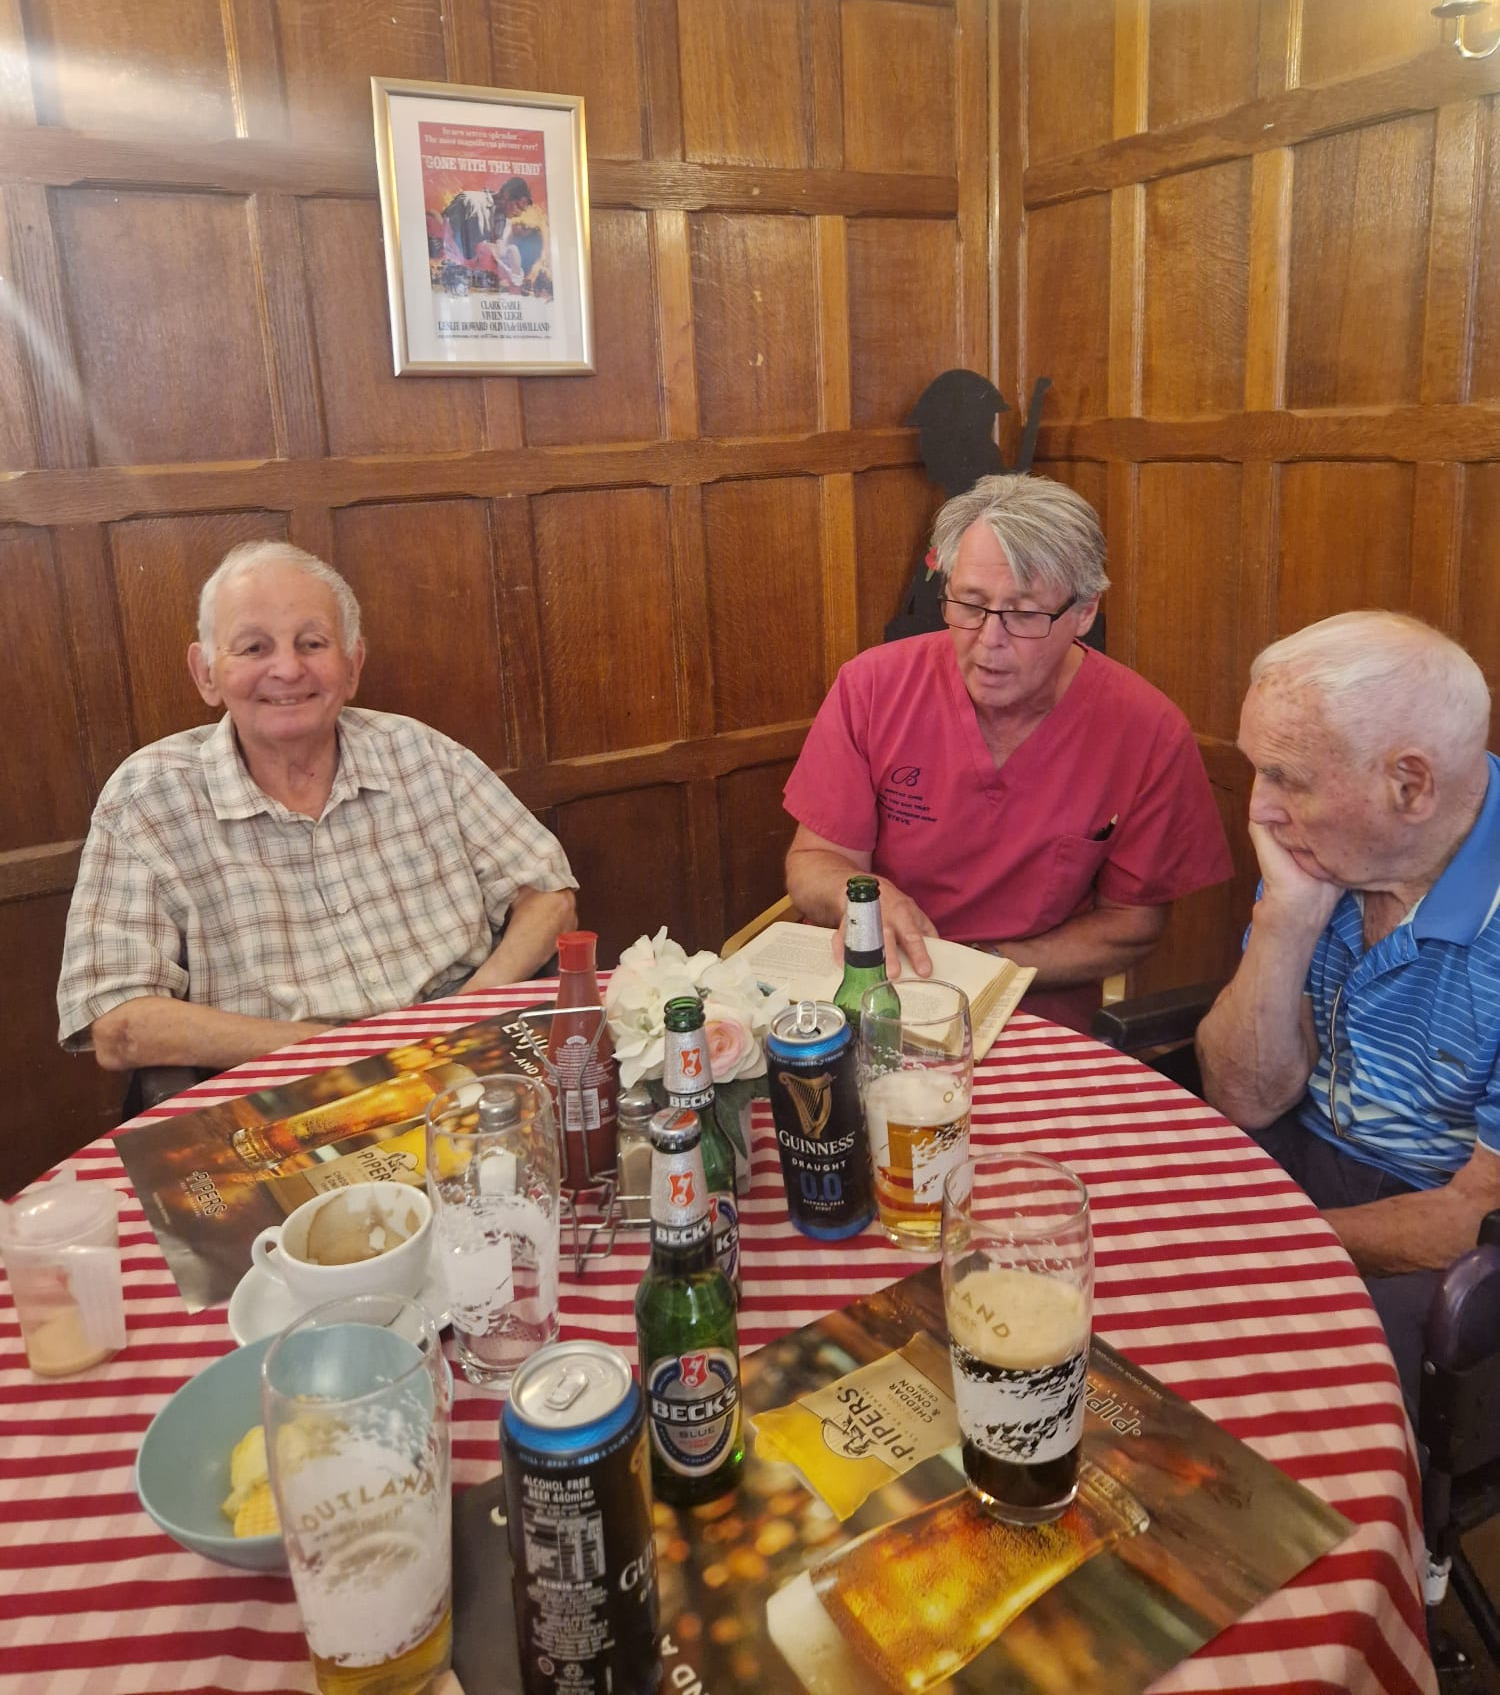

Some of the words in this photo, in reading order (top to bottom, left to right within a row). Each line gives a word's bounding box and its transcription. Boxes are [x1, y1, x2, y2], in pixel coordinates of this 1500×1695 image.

[457, 157, 487, 173] WITH
[488, 160, 511, 174] THE
[480, 300, 501, 310] CLARK
[481, 310, 503, 320] VIVIEN
[887, 813, 911, 826] STEVE
[513, 1058, 539, 1075] AND
[778, 1129, 856, 1156] GUINNESS
[791, 1157, 847, 1171] DRAUGHT
[187, 1171, 228, 1216] PIPERS
[899, 1379, 931, 1408] ONION
[652, 1385, 737, 1422] BECK'S
[889, 1383, 933, 1423] CHEDDAR
[837, 1387, 915, 1460] PIPERS
[679, 1426, 716, 1439] BLUE
[523, 1473, 564, 1492] ALCOHOL
[567, 1475, 591, 1490] FREE
[529, 1486, 550, 1502] BEER
